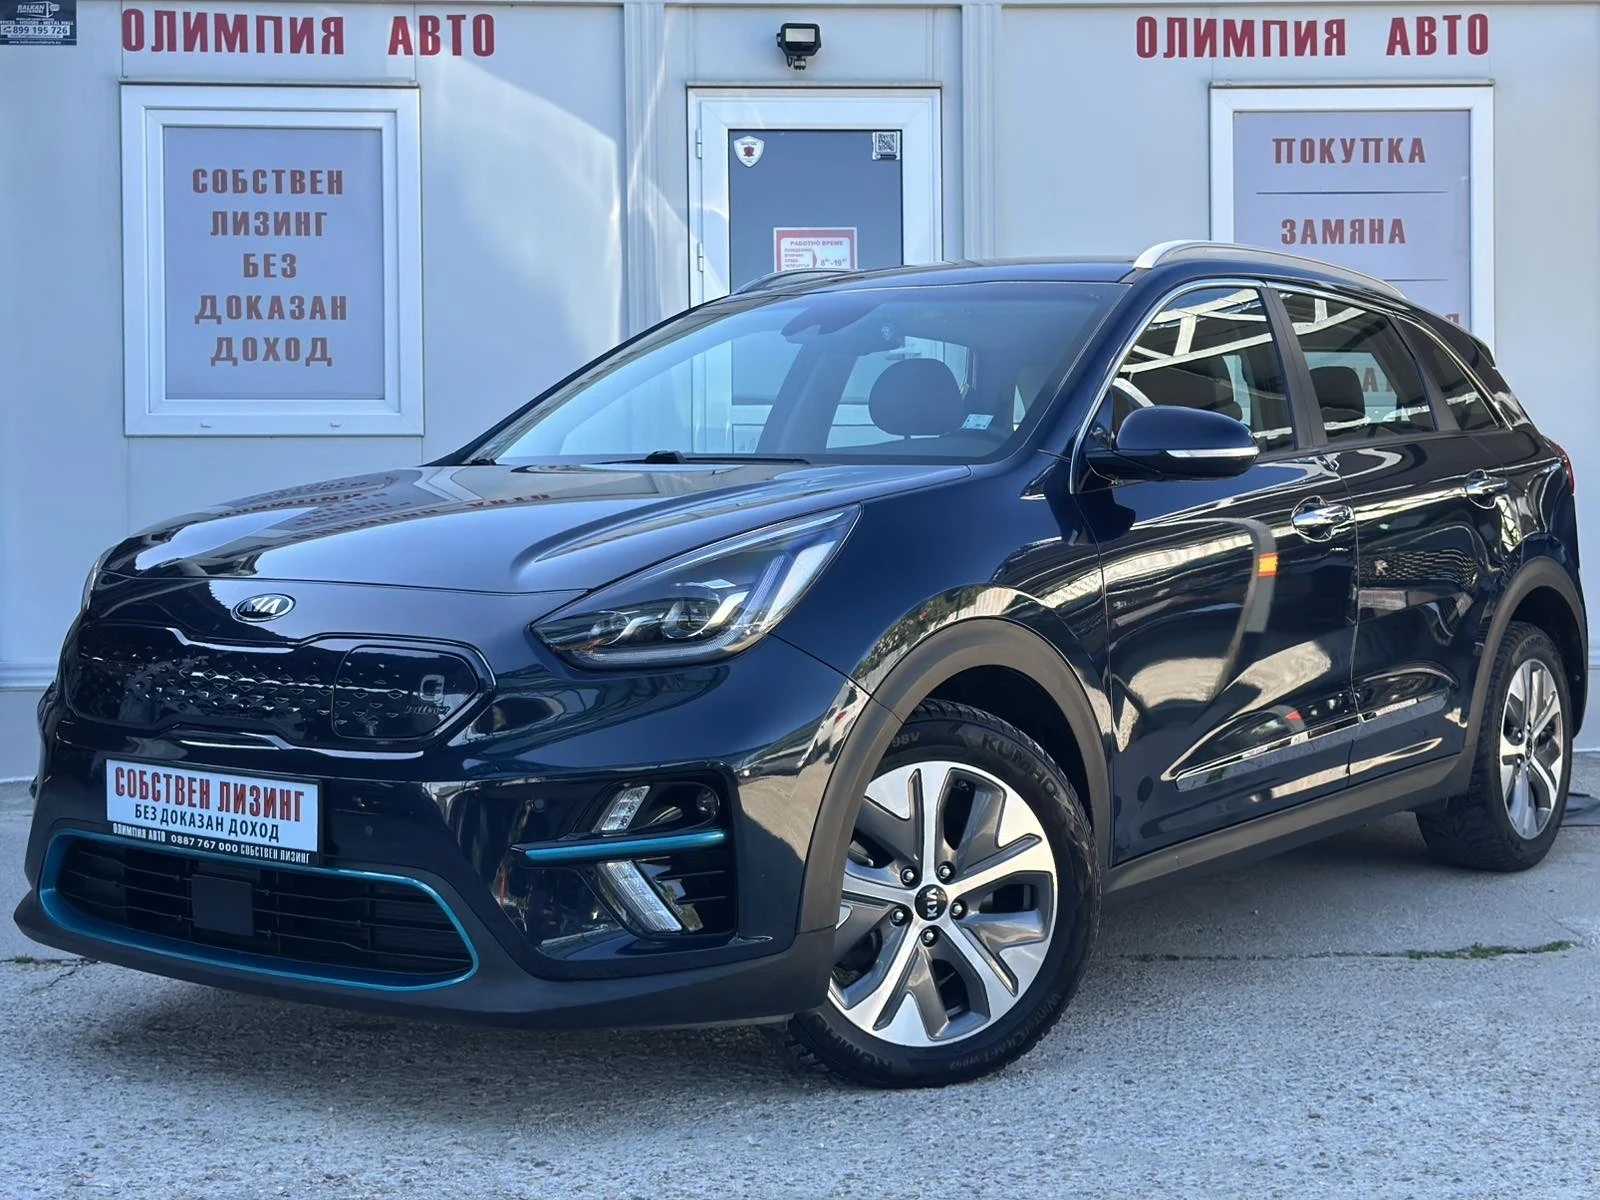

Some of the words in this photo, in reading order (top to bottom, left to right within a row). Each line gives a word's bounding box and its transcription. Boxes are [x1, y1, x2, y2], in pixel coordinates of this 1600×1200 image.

[12, 26, 30, 34] 899
[33, 26, 49, 34] 195
[51, 26, 68, 34] 726
[122, 8, 345, 55] ОЛИМПИЯ
[387, 13, 495, 57] АВТО
[1136, 15, 1346, 59] ОЛИМПИЯ
[1385, 13, 1489, 57] АВТО
[1272, 137, 1426, 164] ПОКУПКА
[192, 168, 344, 195] СОБСТВЕН
[210, 211, 328, 237] ЛИЗИНГ
[1280, 218, 1406, 245] ЗАМЯНА
[243, 253, 297, 279] БЕЗ
[194, 294, 347, 325] ДОКАЗАН
[210, 337, 333, 367] ДОХОД
[115, 766, 211, 810] СОБСТВЕН
[218, 781, 305, 822] ЛИЗИНГ
[135, 804, 157, 821] БЕЗ
[160, 808, 224, 832] ДОКАЗАН
[228, 819, 280, 843] ДОХОД
[112, 822, 147, 839] ОЛИМПИЯ
[148, 829, 166, 843] АВТО
[171, 834, 195, 846] 0887
[197, 839, 216, 850] 767
[218, 842, 239, 853] 000
[240, 844, 278, 860] СОБСТВЕН
[280, 849, 310, 864] ЛИЗИНГ
[926, 887, 938, 918] KIA
